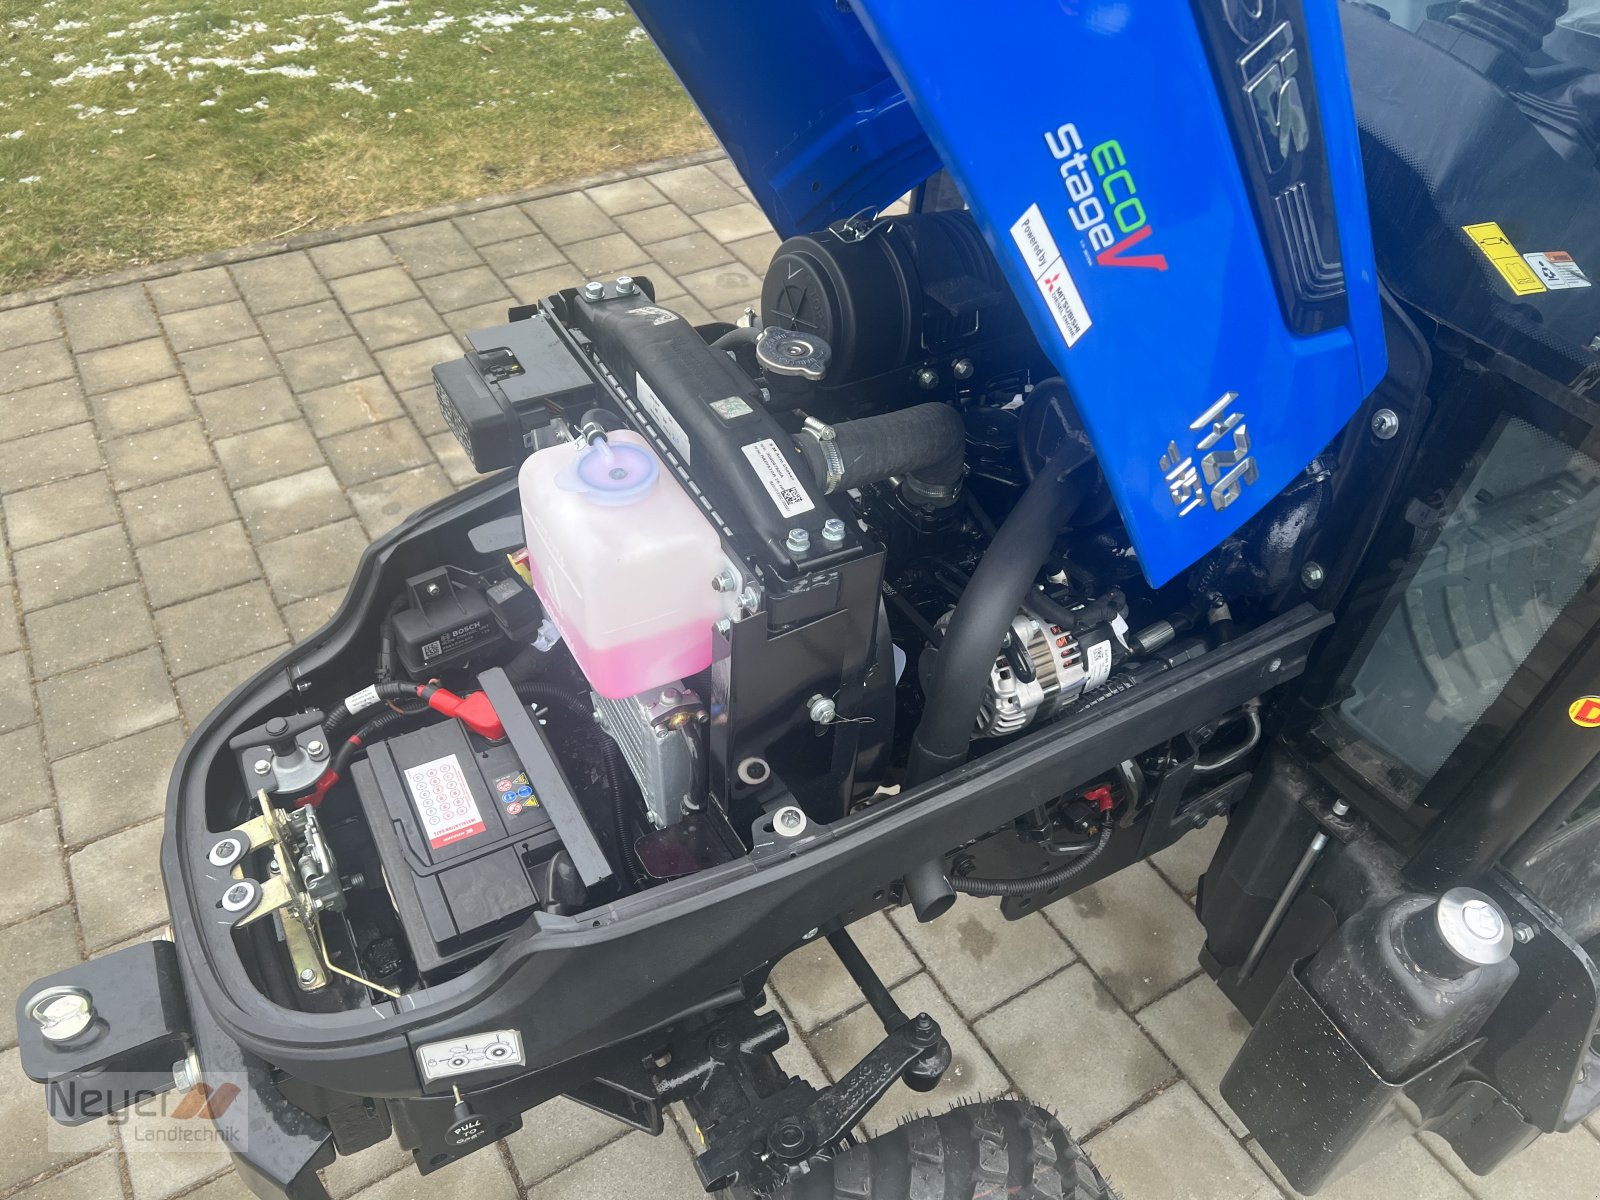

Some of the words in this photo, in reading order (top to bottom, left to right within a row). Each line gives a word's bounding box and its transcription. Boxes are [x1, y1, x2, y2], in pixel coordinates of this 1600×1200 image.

[1044, 122, 1115, 251] Stage
[1096, 224, 1168, 272] V
[1022, 218, 1044, 257] Powered
[1037, 251, 1048, 267] by
[1051, 293, 1064, 315] DIESEL
[1056, 287, 1080, 333] MITSUBISHI
[1189, 391, 1258, 512] H26
[452, 622, 480, 637] BOSCH
[454, 1119, 481, 1135] PULL
[463, 1128, 477, 1137] TO
